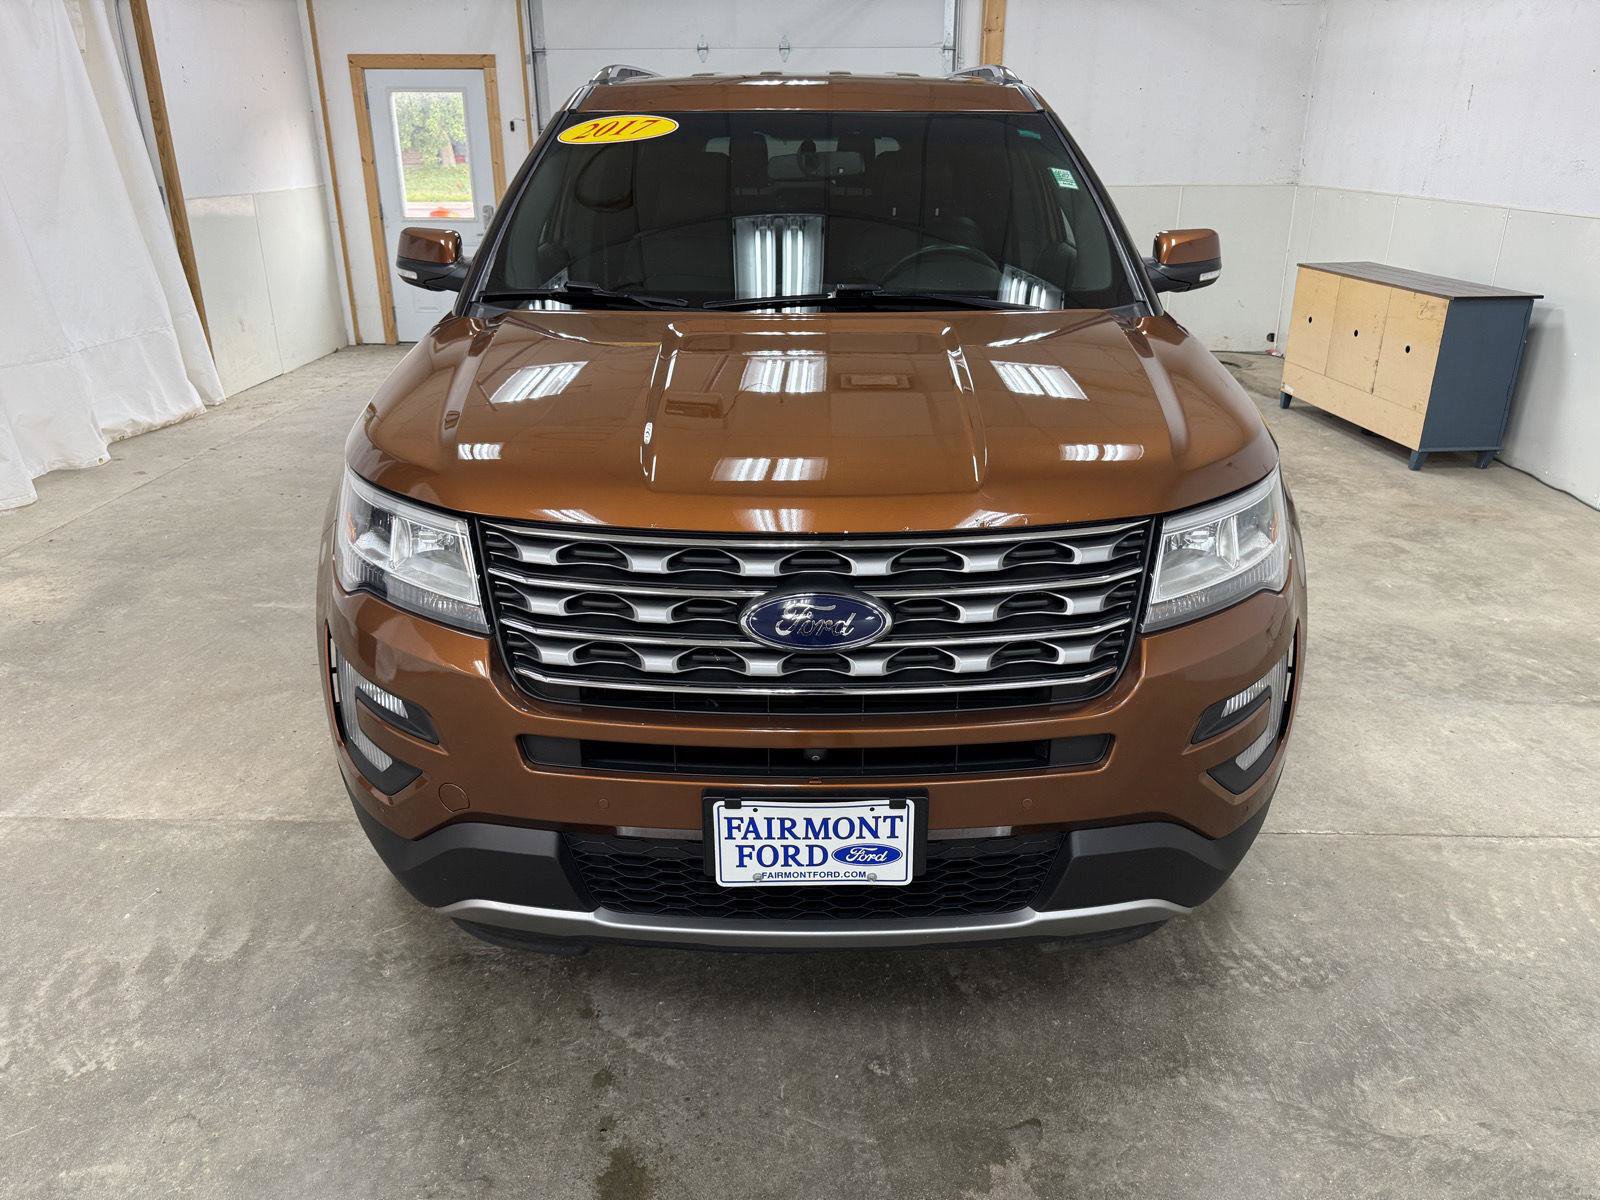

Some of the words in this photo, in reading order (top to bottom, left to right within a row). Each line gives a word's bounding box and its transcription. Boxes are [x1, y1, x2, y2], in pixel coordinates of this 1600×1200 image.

[572, 119, 661, 140] 2017
[774, 600, 855, 636] Ford
[723, 814, 904, 840] FAIRMONT
[735, 843, 829, 868] FORD
[845, 847, 888, 862] Ford
[761, 871, 867, 880] FAIRMONTFORD.COM
